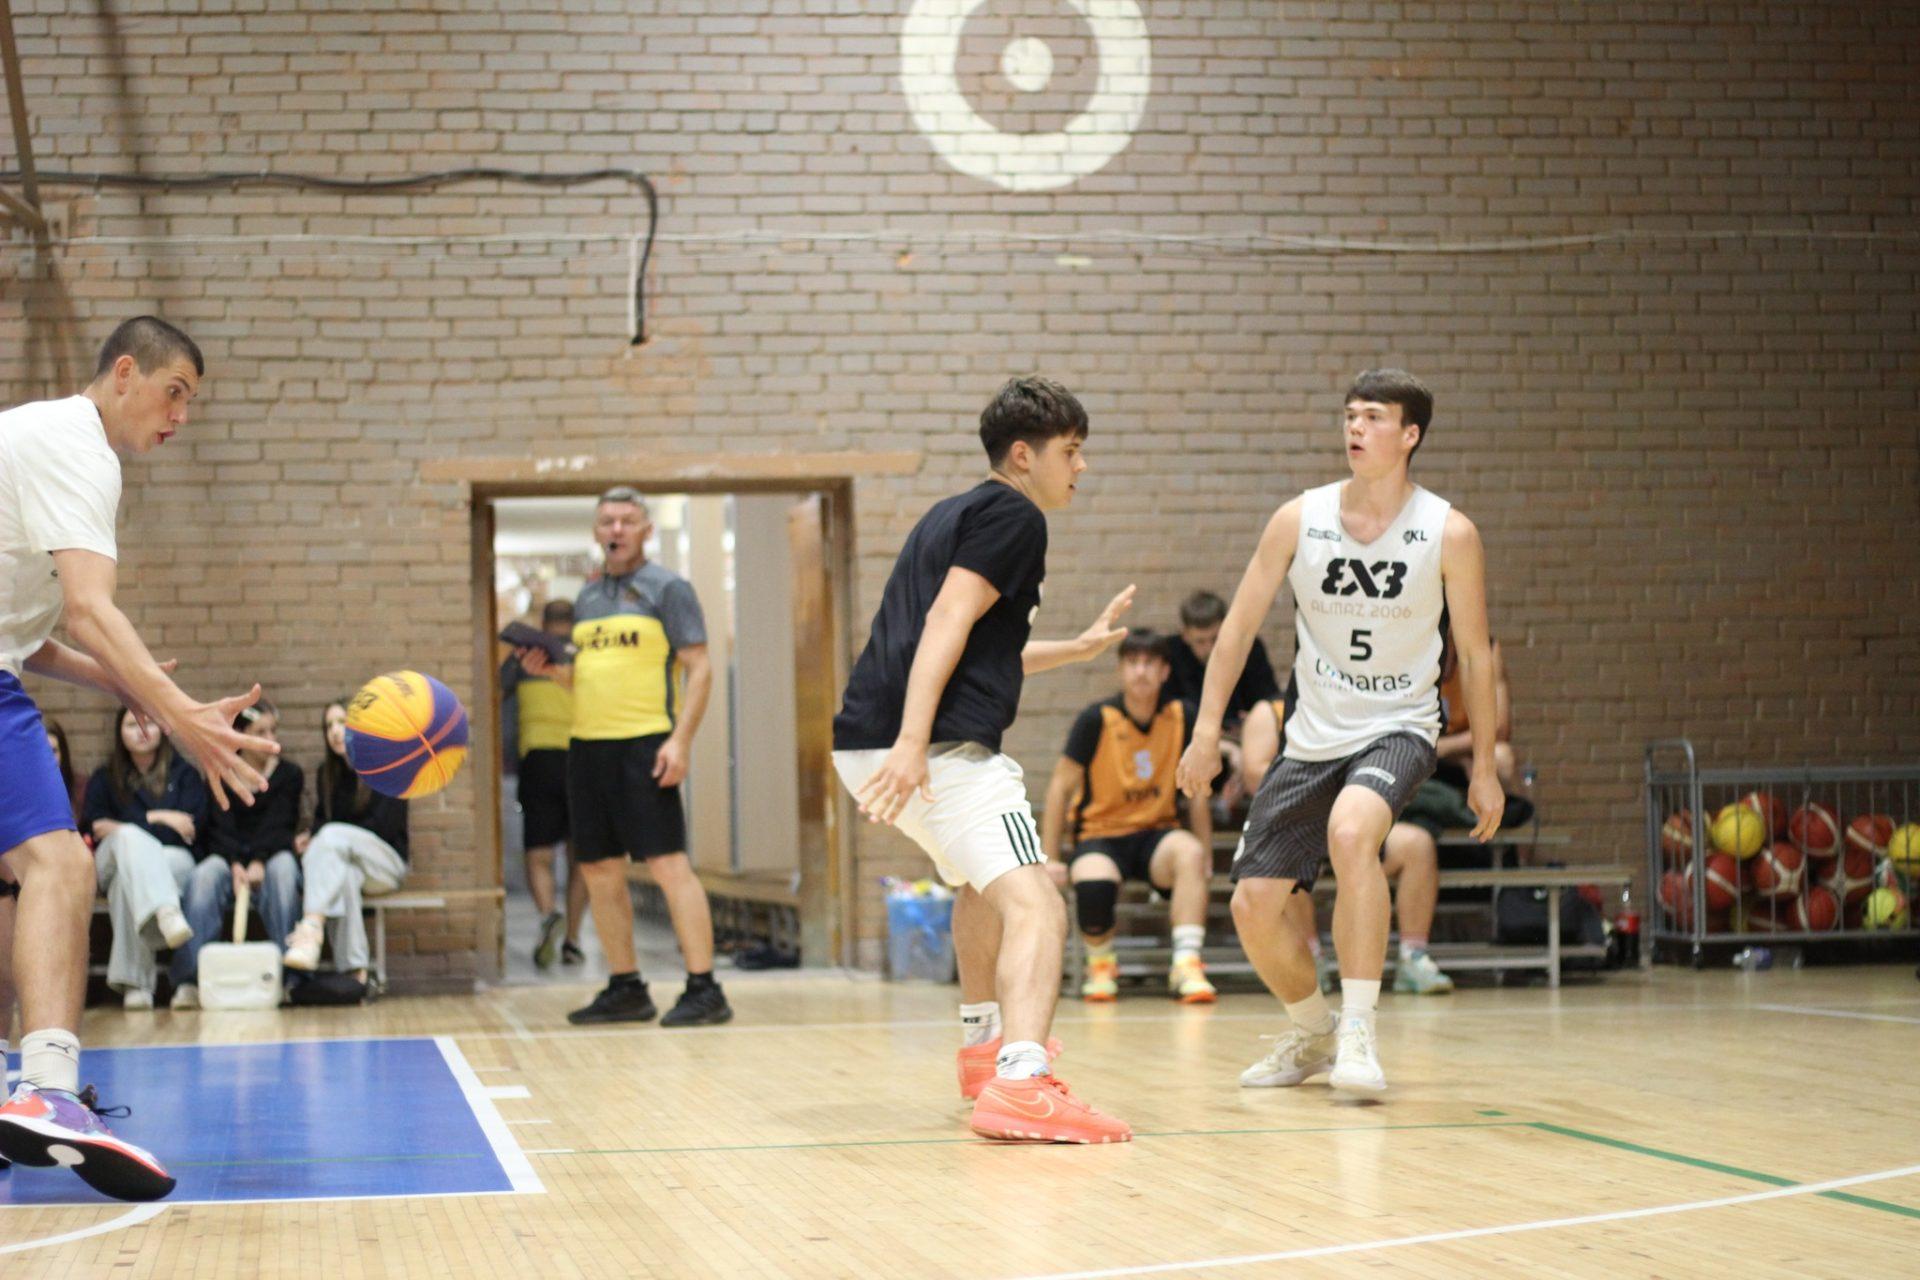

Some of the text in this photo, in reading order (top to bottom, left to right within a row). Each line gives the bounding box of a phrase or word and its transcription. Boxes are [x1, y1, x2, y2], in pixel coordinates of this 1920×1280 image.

[1311, 599, 1412, 619] ALMAZ 2006
[1350, 629, 1373, 661] 5
